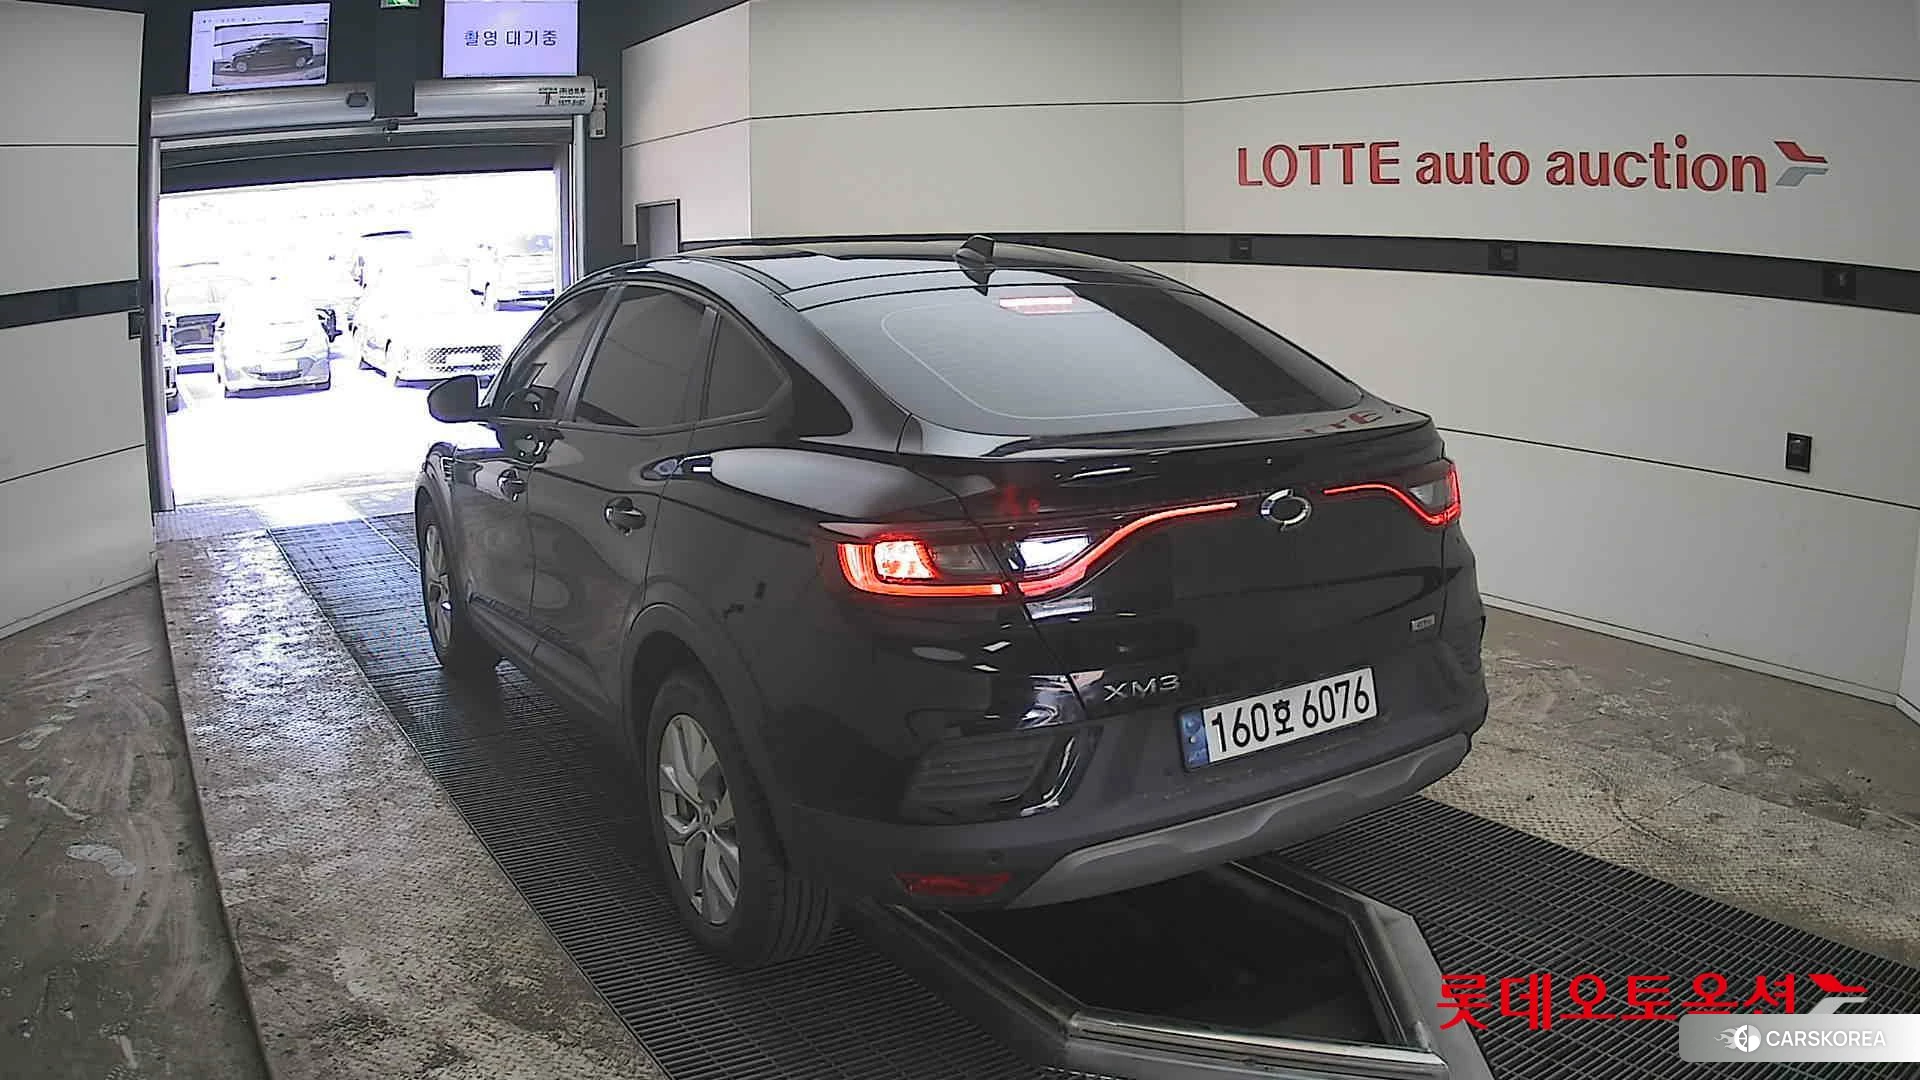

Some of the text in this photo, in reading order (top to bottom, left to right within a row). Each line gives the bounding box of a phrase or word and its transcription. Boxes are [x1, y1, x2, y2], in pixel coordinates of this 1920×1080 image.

[465, 30, 558, 47] 촬영 대기중
[1237, 133, 1768, 193] LOTTE auto auction
[1103, 674, 1181, 701] XM3
[1211, 675, 1370, 752] 160호 6076
